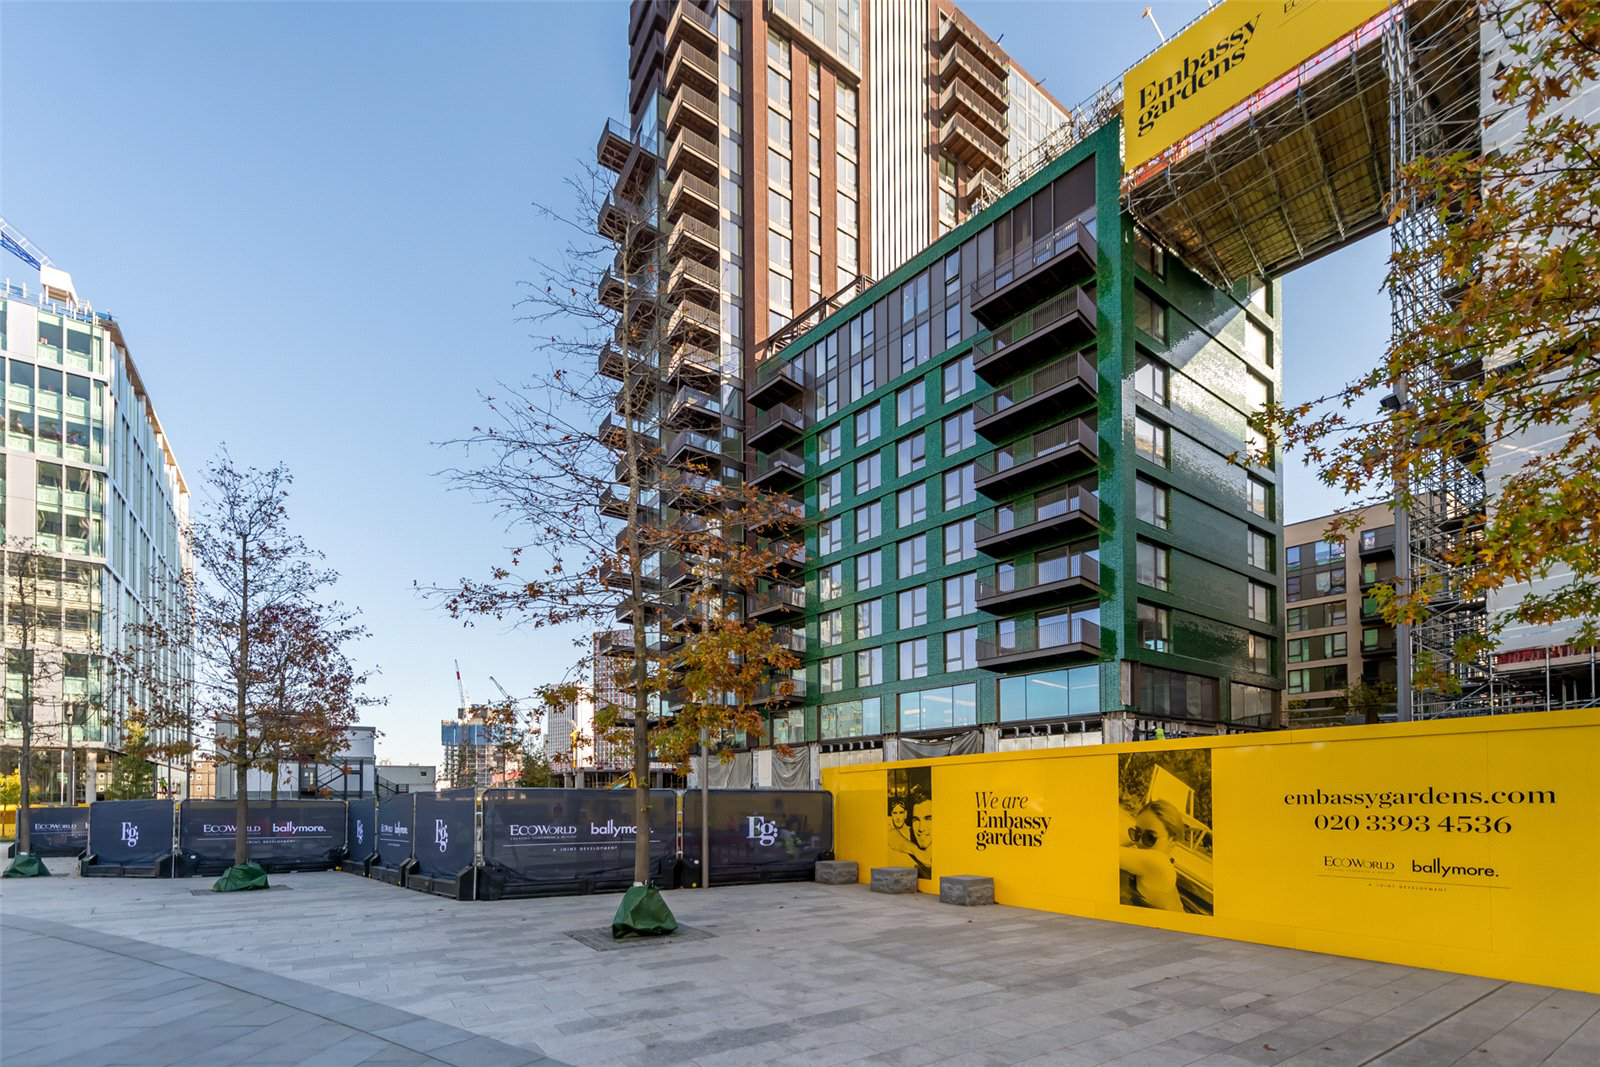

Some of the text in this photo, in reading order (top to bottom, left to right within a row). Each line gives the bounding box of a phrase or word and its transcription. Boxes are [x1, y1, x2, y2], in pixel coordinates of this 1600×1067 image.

[1138, 13, 1262, 111] Embassy
[1137, 46, 1246, 138] gardens
[975, 791, 1029, 809] We are
[1283, 787, 1556, 809] embassygardens.com
[272, 821, 327, 834] ballymore.
[975, 810, 1052, 834] Embassy
[1314, 814, 1512, 834] 020 3393 4536
[975, 829, 1043, 851] gardens
[1411, 857, 1500, 878] ballymore.
